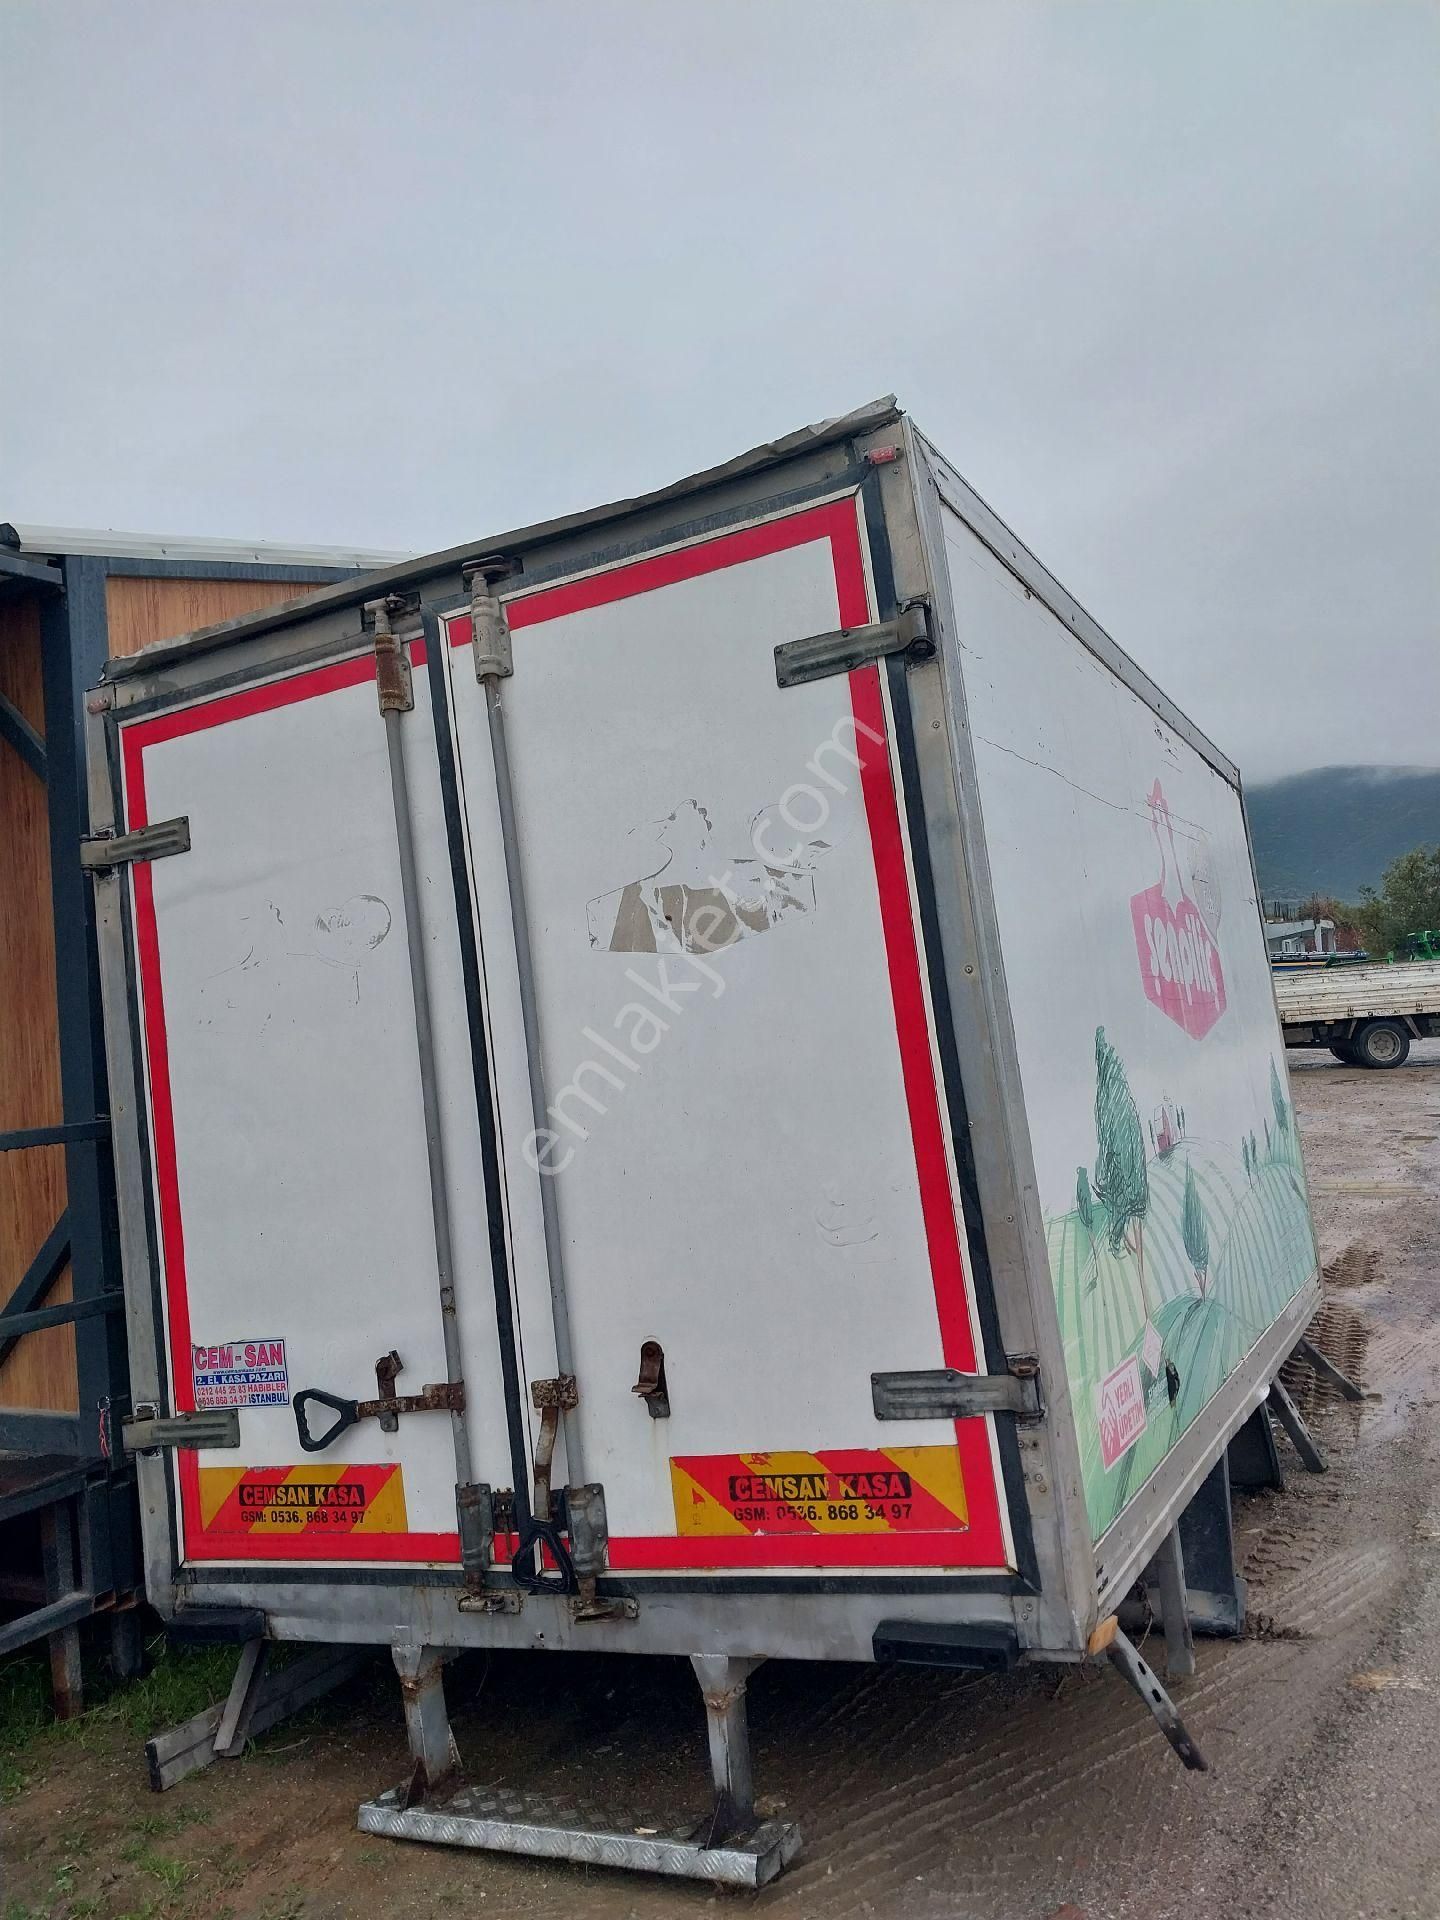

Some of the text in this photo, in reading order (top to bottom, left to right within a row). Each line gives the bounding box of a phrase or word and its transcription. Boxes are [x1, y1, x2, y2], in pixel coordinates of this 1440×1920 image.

[197, 1371, 284, 1385] 2. EL KASA PAZARI
[229, 1385, 237, 1394] 25
[735, 1473, 906, 1500] CEMSAN KASA
[242, 1486, 362, 1506] CEMSAN KASA
[241, 1510, 365, 1523] GSM: 0536. 868 34 97
[733, 1507, 770, 1521] GSM:
[828, 1504, 859, 1520] 868
[864, 1504, 886, 1520] 34
[892, 1503, 912, 1520] 97
